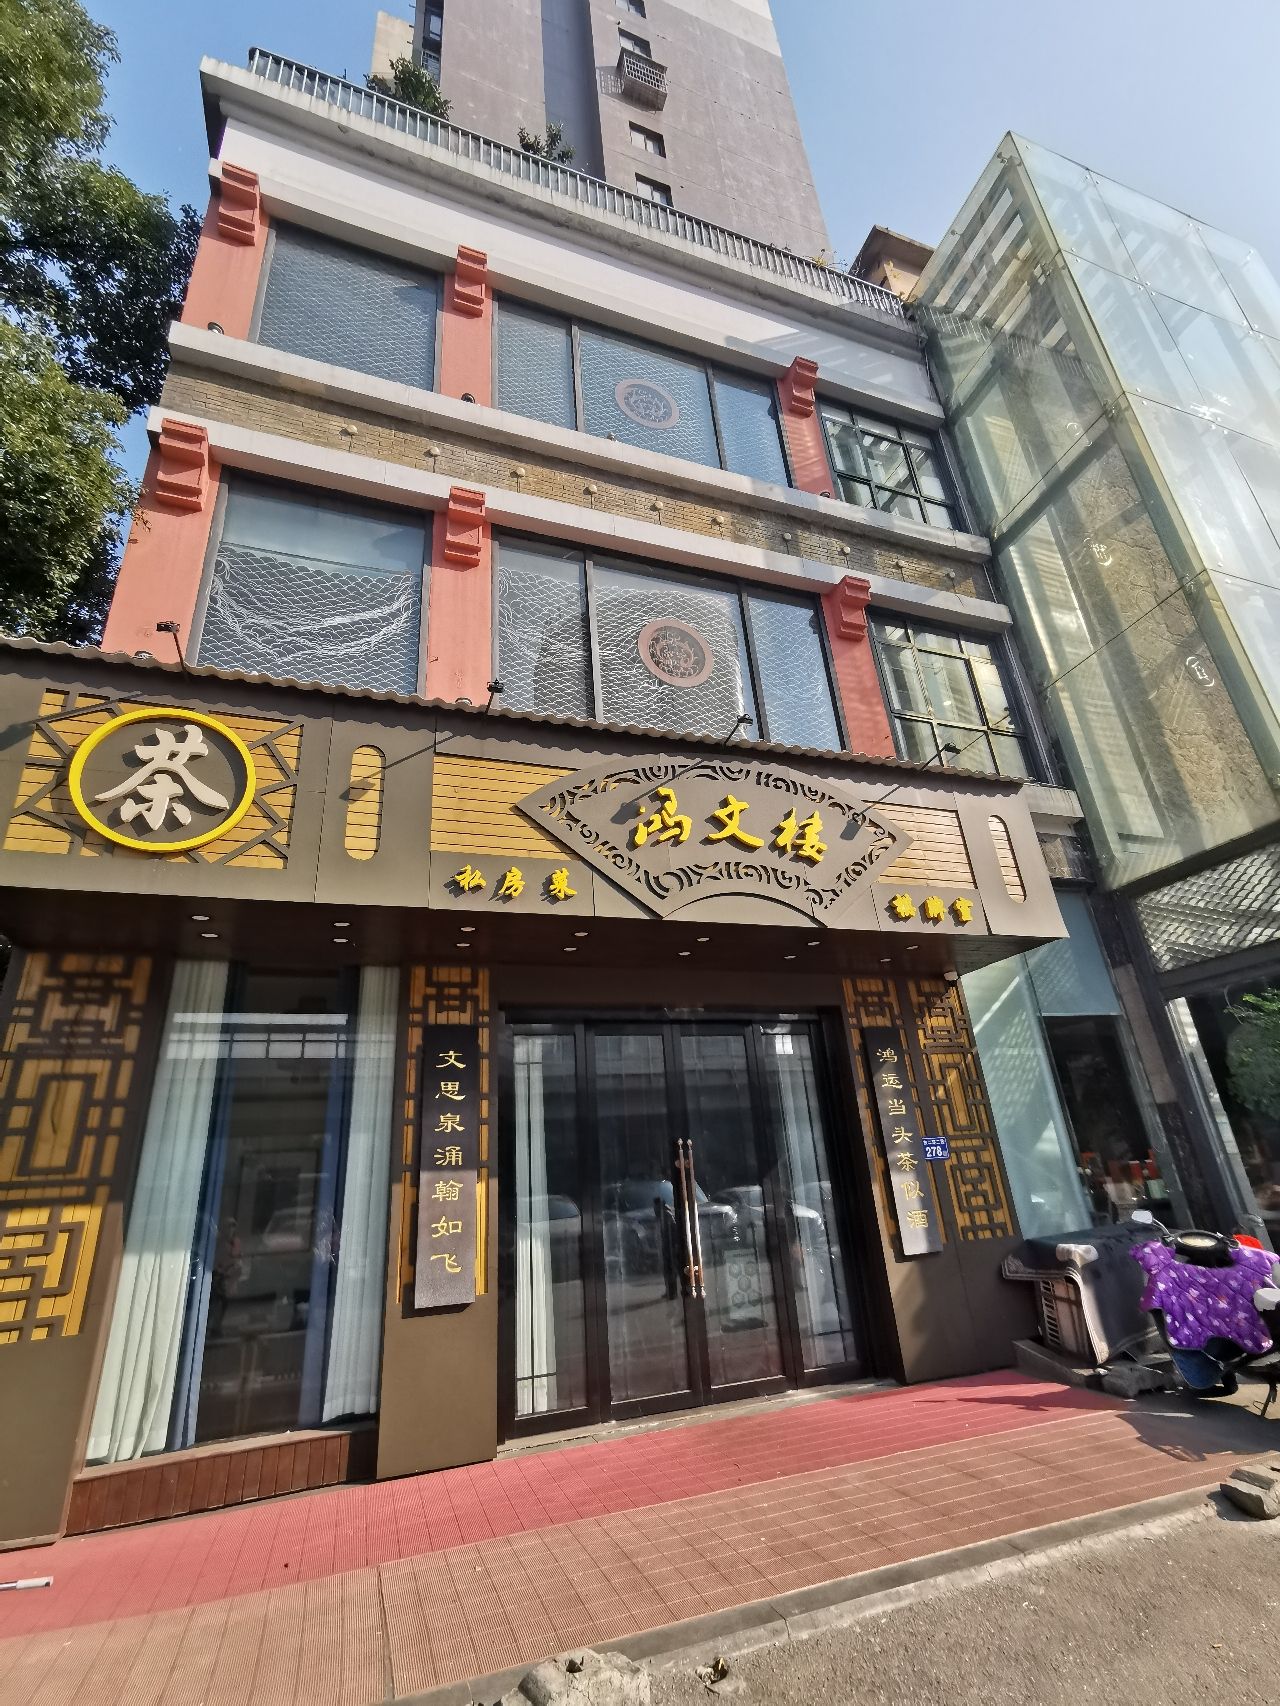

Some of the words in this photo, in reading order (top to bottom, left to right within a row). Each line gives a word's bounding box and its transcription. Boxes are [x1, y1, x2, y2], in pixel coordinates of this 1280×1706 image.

[95, 724, 229, 831] 茶
[634, 786, 828, 863] 鸿文楼
[454, 864, 578, 899] 私房菜
[430, 1050, 467, 1273] 文思泉涌翰如飞
[876, 1048, 928, 1229] 鸿运当头茶似酒
